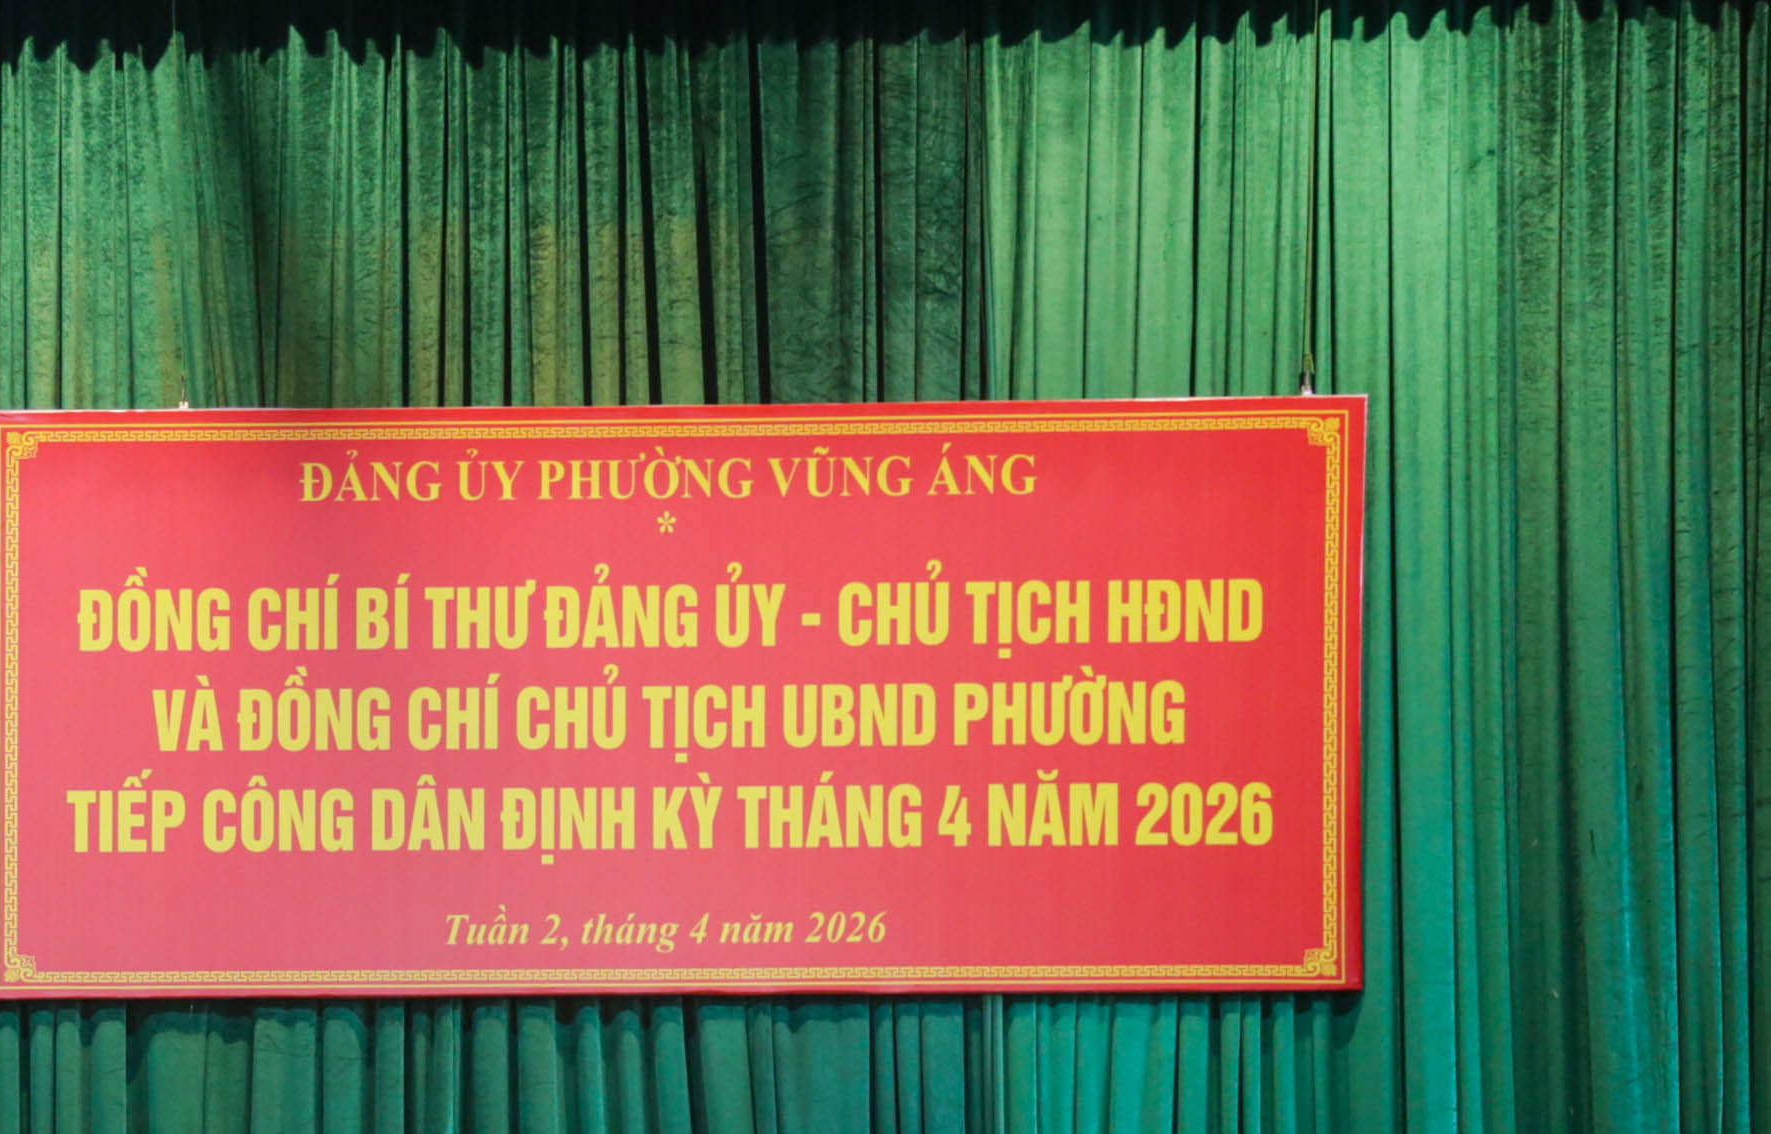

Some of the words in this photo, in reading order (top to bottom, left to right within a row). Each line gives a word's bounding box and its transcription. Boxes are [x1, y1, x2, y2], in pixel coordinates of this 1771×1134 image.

[300, 450, 442, 502] ĐẢNG
[457, 448, 524, 502] ỦY
[537, 445, 754, 501] PHƯỜNG
[768, 446, 913, 498] VŨNG
[927, 442, 1037, 496] ÁNG
[76, 565, 232, 653] ĐỒNG
[247, 573, 341, 652] CHÍ
[355, 572, 411, 651] BÍ
[423, 578, 538, 651] THƯ
[542, 562, 699, 650] ĐẢNG
[714, 561, 787, 649] ỦY
[800, 612, 822, 627] -
[837, 559, 951, 647] CHỦ
[964, 579, 1091, 660] TỊCH
[1107, 578, 1264, 644] HĐND
[151, 674, 225, 753] VÀ
[236, 665, 392, 753] ĐỒNG
[407, 672, 502, 752] CHÍ
[515, 663, 628, 751] CHỦ
[641, 683, 767, 764] TỊCH
[782, 682, 937, 749] UBND
[953, 664, 1186, 747] PHƯỜNG
[65, 766, 187, 854] TIẾP
[202, 774, 355, 854] CÔNG
[370, 773, 486, 852] DÂN
[499, 785, 637, 866] ĐỊNH
[652, 771, 725, 851] KỲ
[735, 770, 923, 850] THÁNG
[937, 784, 973, 848] 4
[987, 768, 1120, 847] NĂM
[1135, 781, 1274, 847] 2026
[445, 903, 531, 946] Tuần
[539, 913, 570, 952] 2,
[580, 911, 681, 954] tháng
[688, 911, 710, 945] 4
[718, 912, 795, 945] năm
[804, 910, 887, 944] 2026
